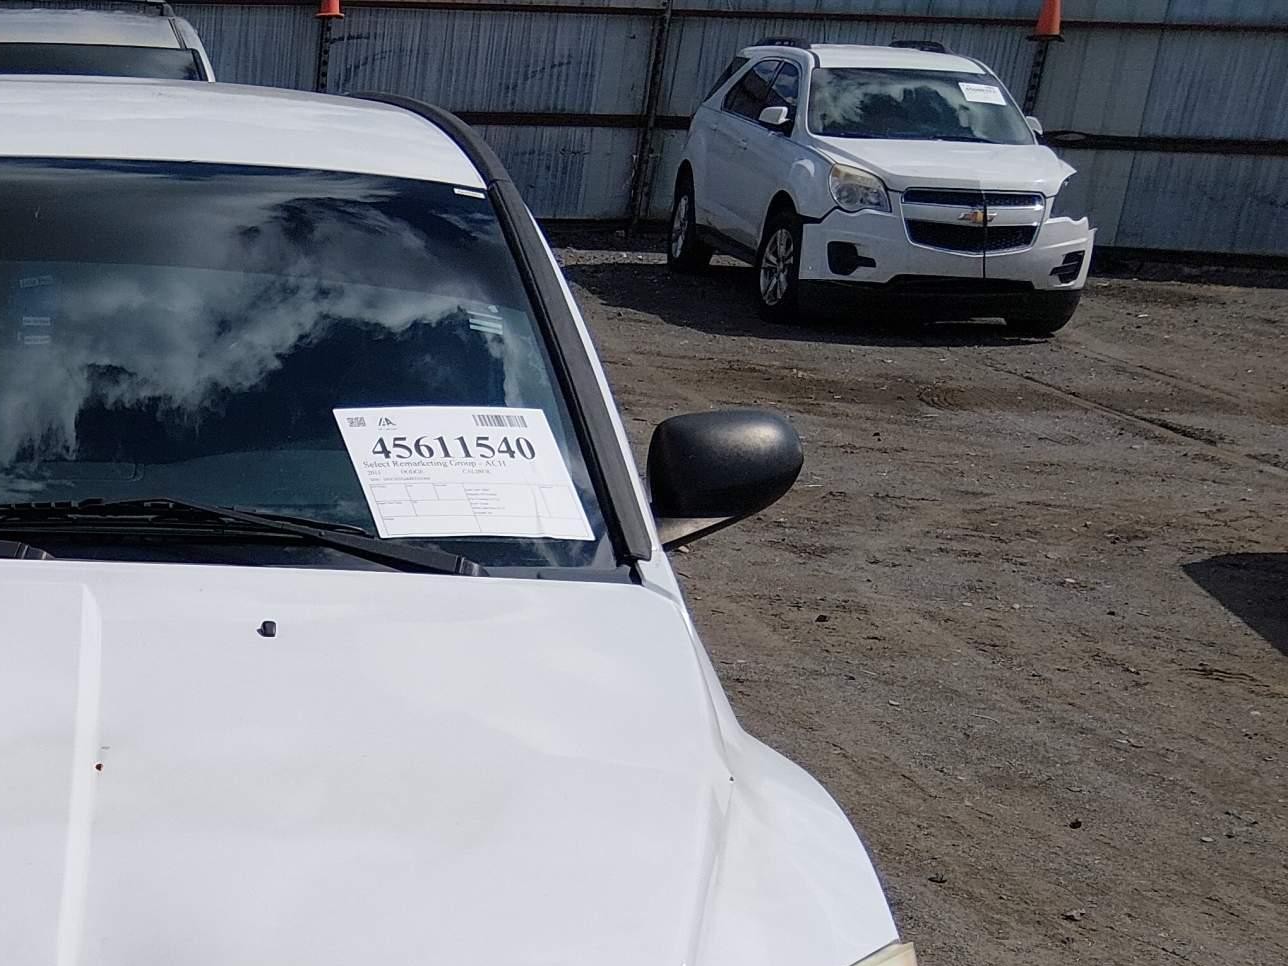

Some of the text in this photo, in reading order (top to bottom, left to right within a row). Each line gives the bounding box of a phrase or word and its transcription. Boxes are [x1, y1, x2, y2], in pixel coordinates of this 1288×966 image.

[372, 435, 536, 460] 45611540
[363, 460, 390, 468] Select
[392, 459, 448, 468] Remarketing
[451, 459, 477, 468] Group
